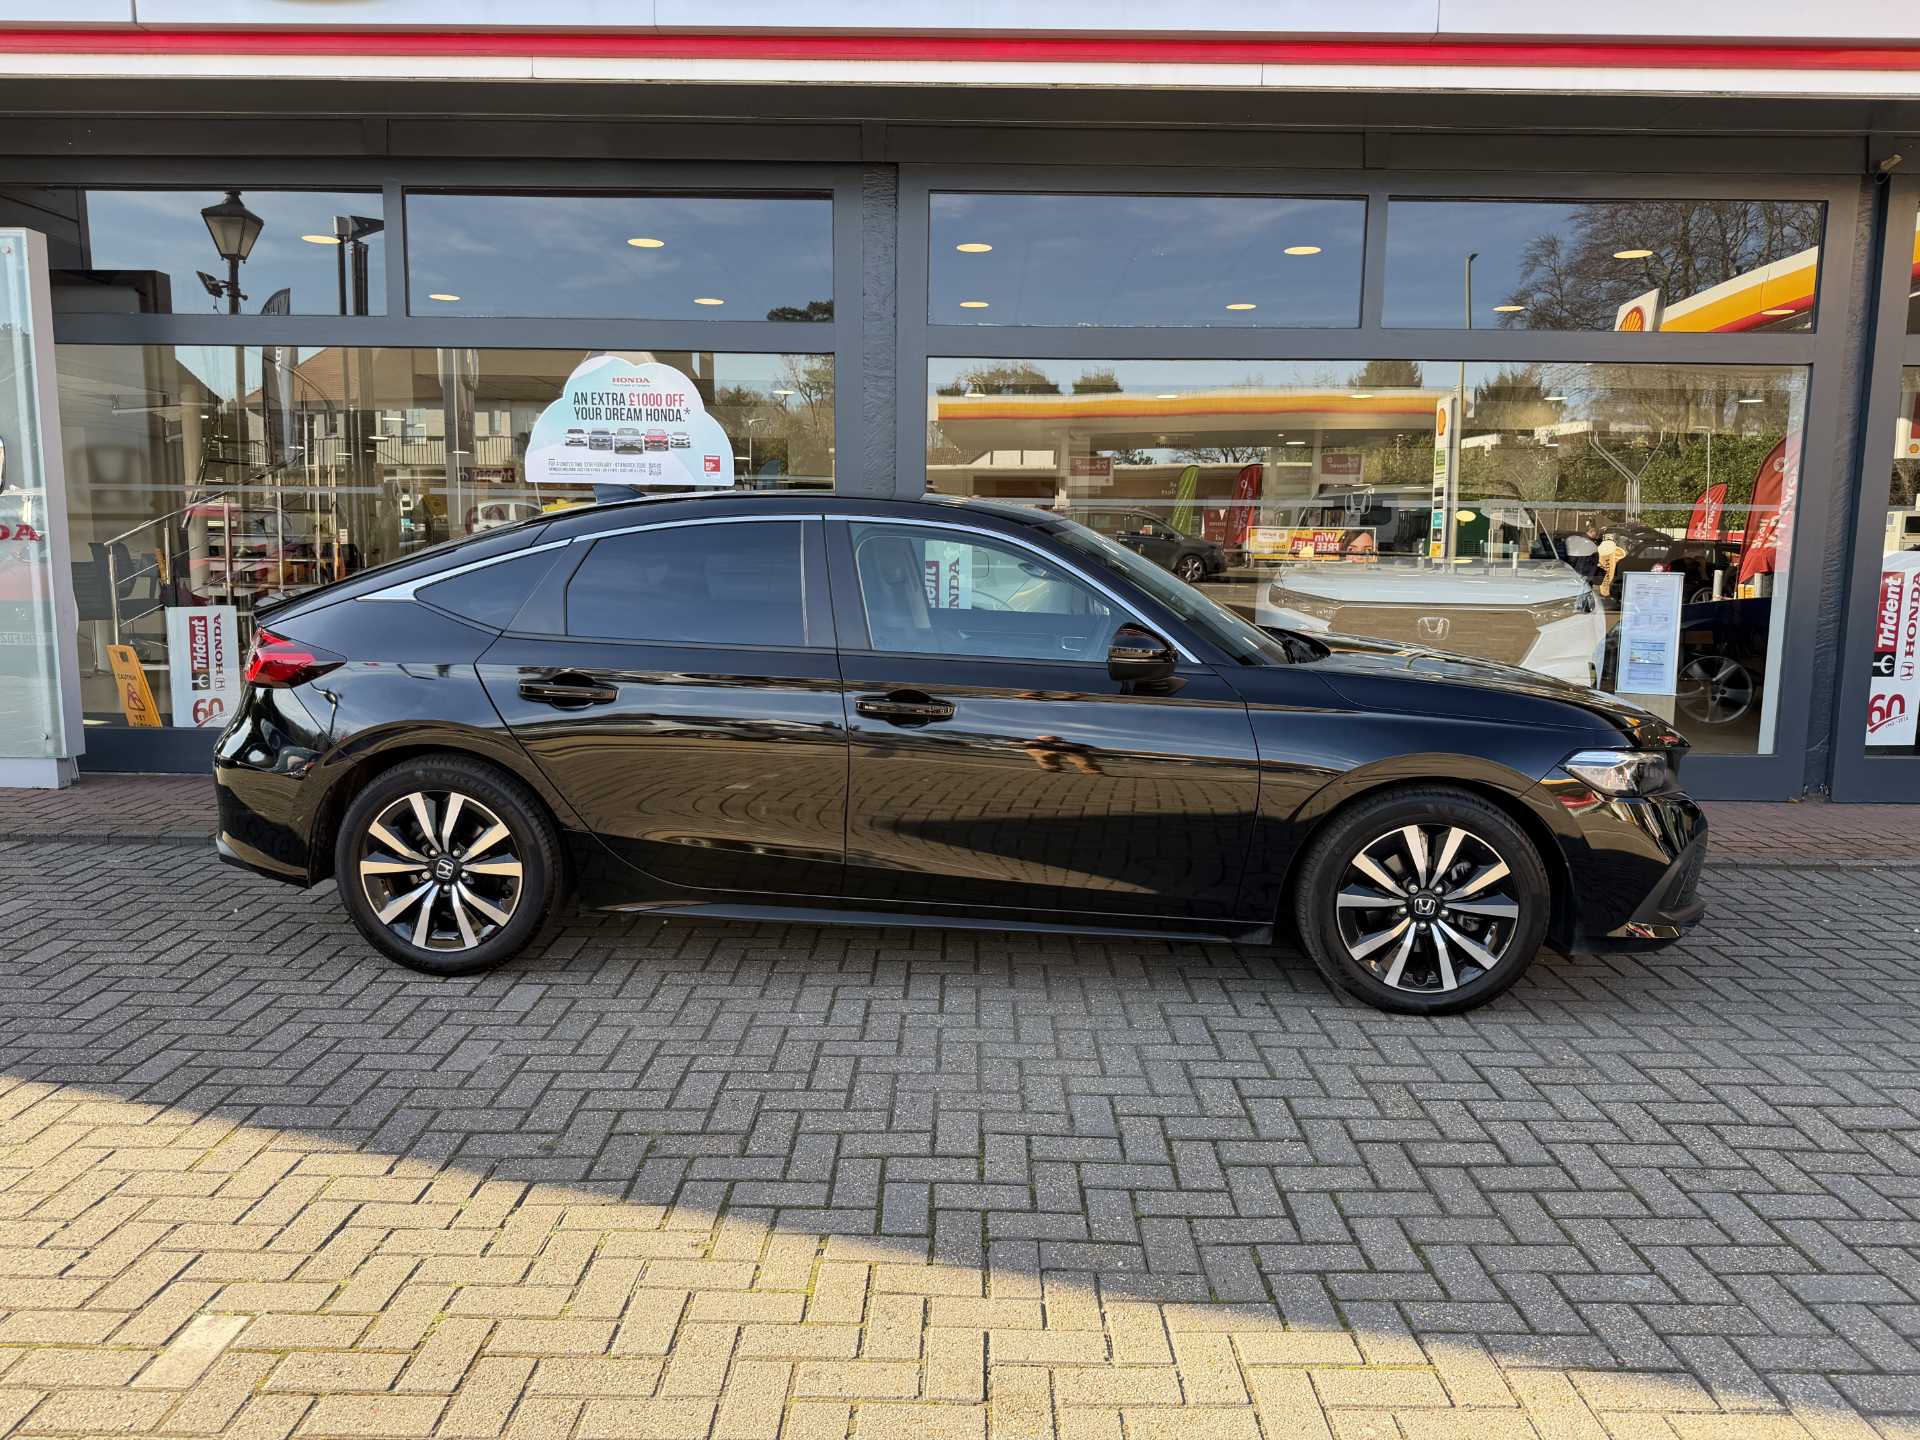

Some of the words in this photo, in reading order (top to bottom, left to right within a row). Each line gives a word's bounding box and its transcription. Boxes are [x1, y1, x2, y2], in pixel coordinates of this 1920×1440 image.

[612, 376, 650, 384] HONDA
[573, 392, 588, 406] AN
[591, 392, 626, 407] EXTRA
[628, 392, 662, 407] £1000
[665, 393, 685, 408] OFF
[574, 407, 602, 421] YOUR
[605, 407, 643, 422] DREAM
[1878, 576, 1901, 648] Trident
[192, 619, 207, 671] Trident
[213, 613, 224, 674] HONDA
